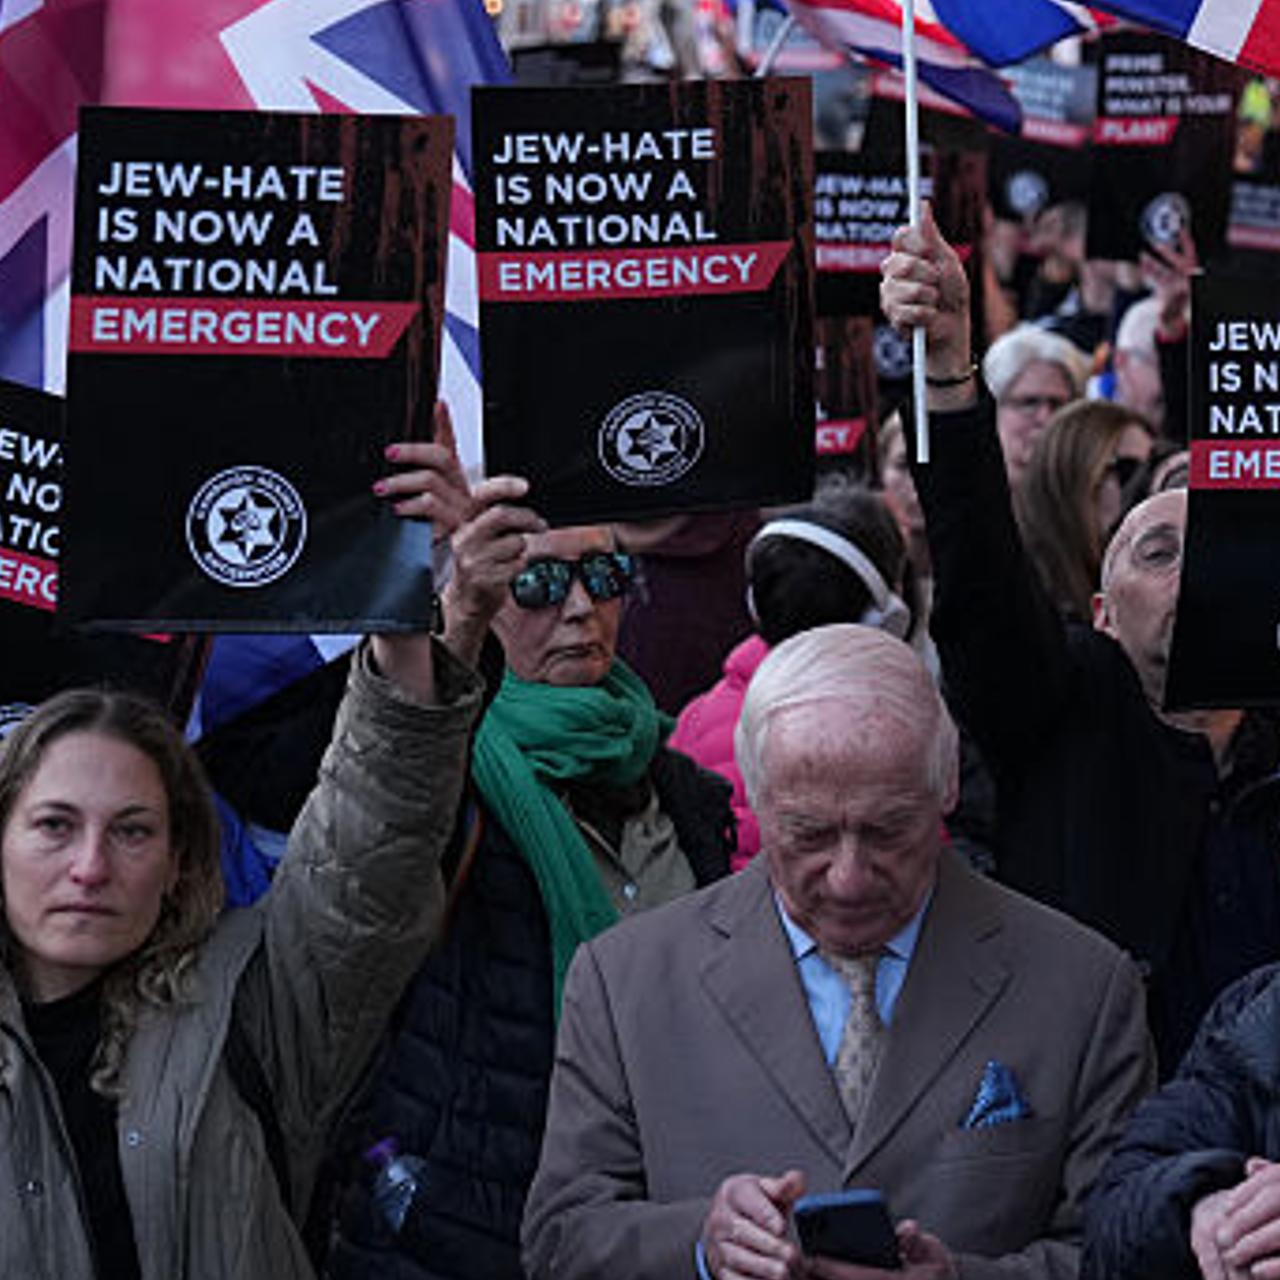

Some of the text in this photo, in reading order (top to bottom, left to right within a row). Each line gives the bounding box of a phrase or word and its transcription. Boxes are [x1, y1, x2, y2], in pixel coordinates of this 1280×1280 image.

[493, 128, 716, 165] JEW-HATE
[98, 162, 345, 201] JEW-HATE
[495, 170, 696, 205] IS NOW A
[816, 174, 934, 196] JEW-HAE
[98, 207, 320, 247] IS NOW A
[838, 199, 900, 218] NOW
[495, 211, 717, 247] NATIONAL
[95, 256, 338, 295] NATIONAL
[499, 253, 757, 292] EMERGENCY
[93, 308, 380, 346] EMERGENCY
[1209, 362, 1241, 392] IS
[6, 473, 61, 512] NO
